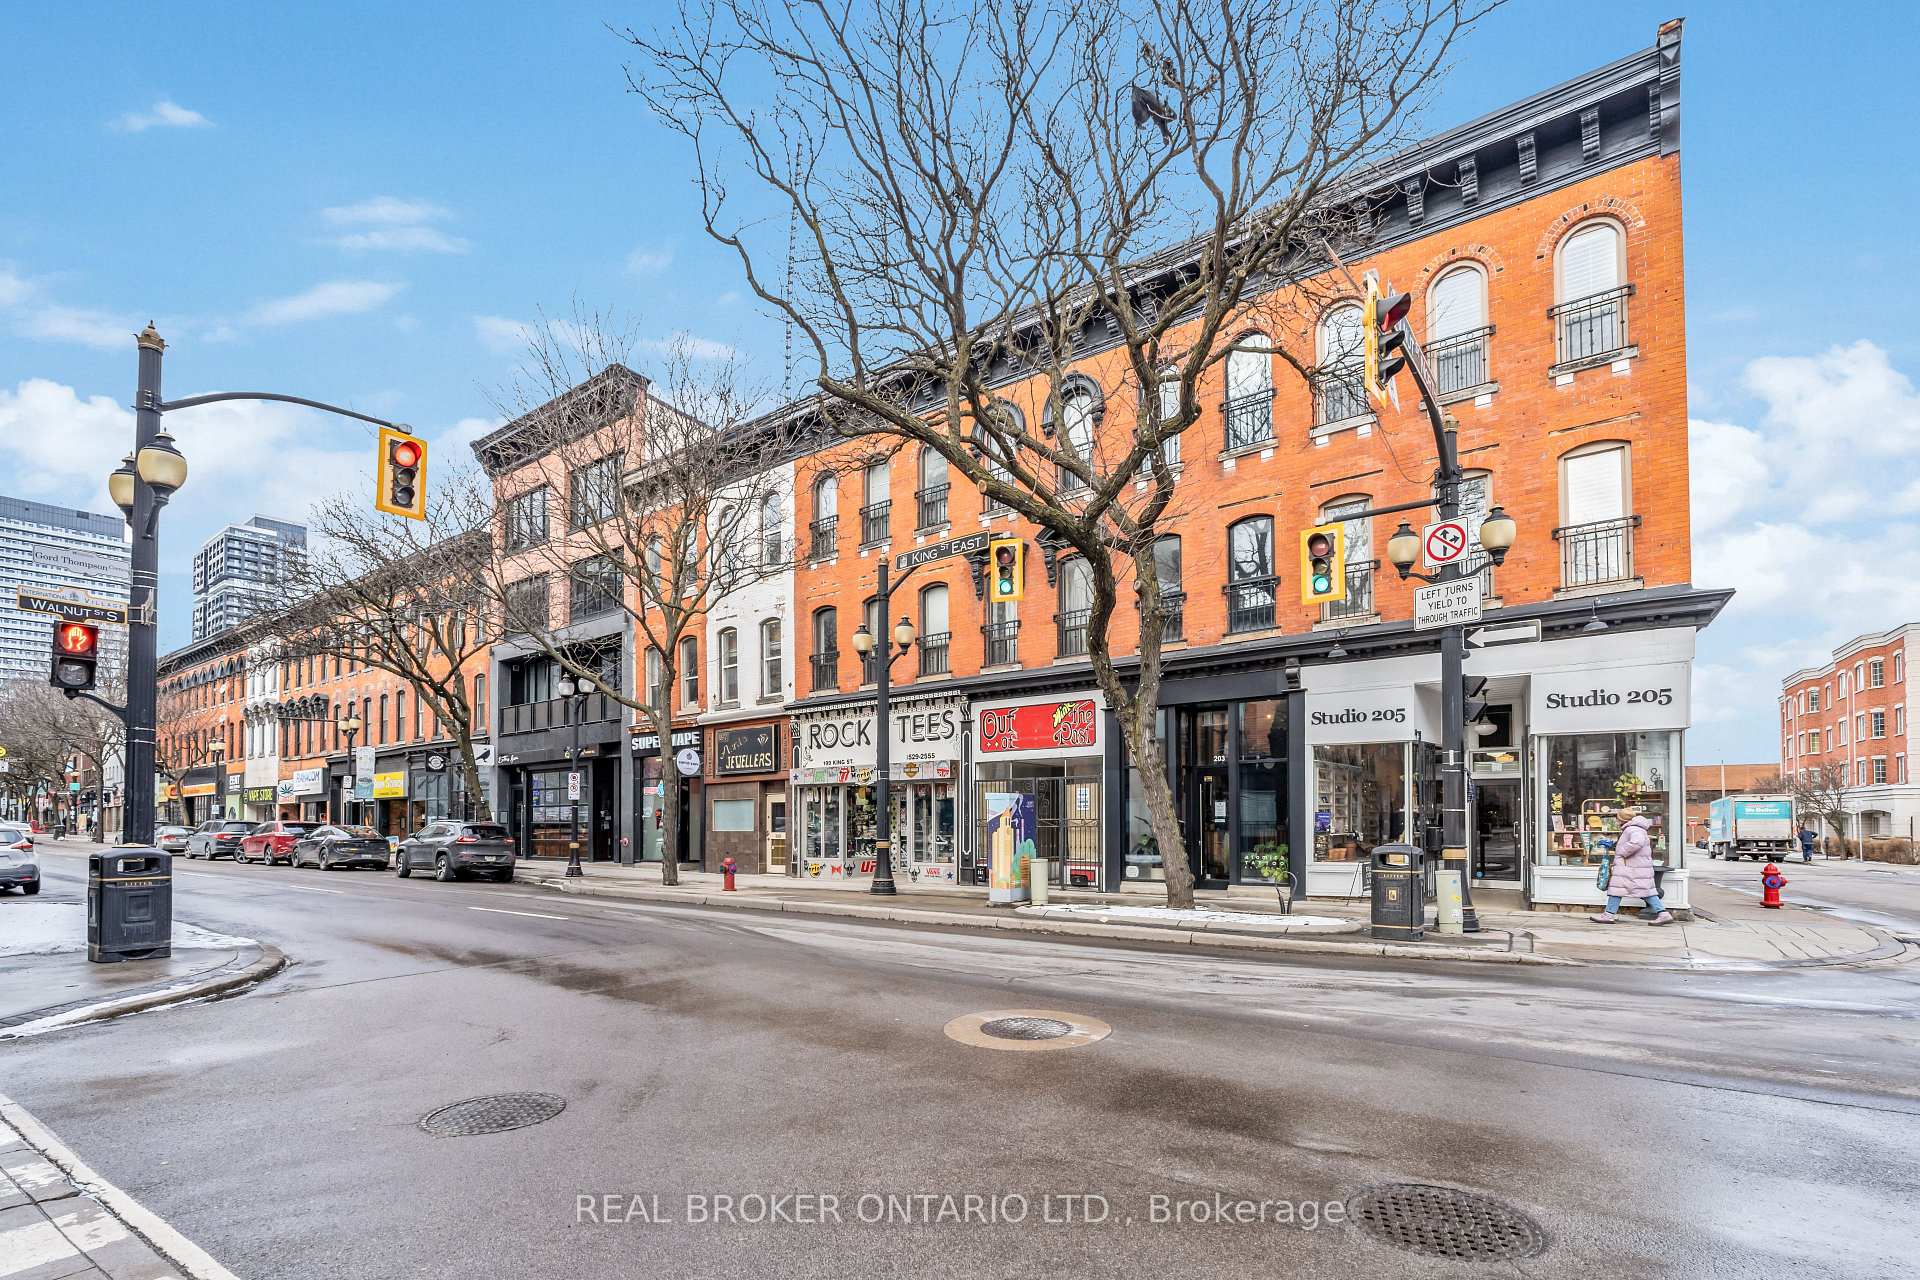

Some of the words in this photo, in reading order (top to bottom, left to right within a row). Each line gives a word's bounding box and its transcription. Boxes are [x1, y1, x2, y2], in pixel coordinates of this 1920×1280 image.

[912, 549, 937, 564] KING
[951, 537, 982, 554] EAST
[35, 551, 58, 561] Gord
[60, 555, 108, 571] Thompson
[21, 588, 66, 599] INTERNATIONAL
[84, 598, 123, 609] VILLAGE
[1421, 589, 1441, 601] LEFT
[1445, 582, 1474, 596] TURNS
[30, 599, 92, 617] WALNUT
[106, 611, 118, 622] S
[1428, 599, 1452, 611] YIELD
[1456, 596, 1467, 606] TO
[1417, 612, 1448, 625] THROUGH
[1450, 606, 1478, 619] TRAFFIC
[1546, 688, 1621, 709] Studio
[1627, 688, 1673, 706] 205
[1311, 708, 1368, 726] Studio
[1371, 707, 1406, 723] 205
[809, 718, 872, 750] ROCK
[893, 709, 955, 744] TEES
[631, 735, 661, 751] SUPE
[725, 752, 772, 769] JEWELLERS
[260, 788, 273, 801] STORE
